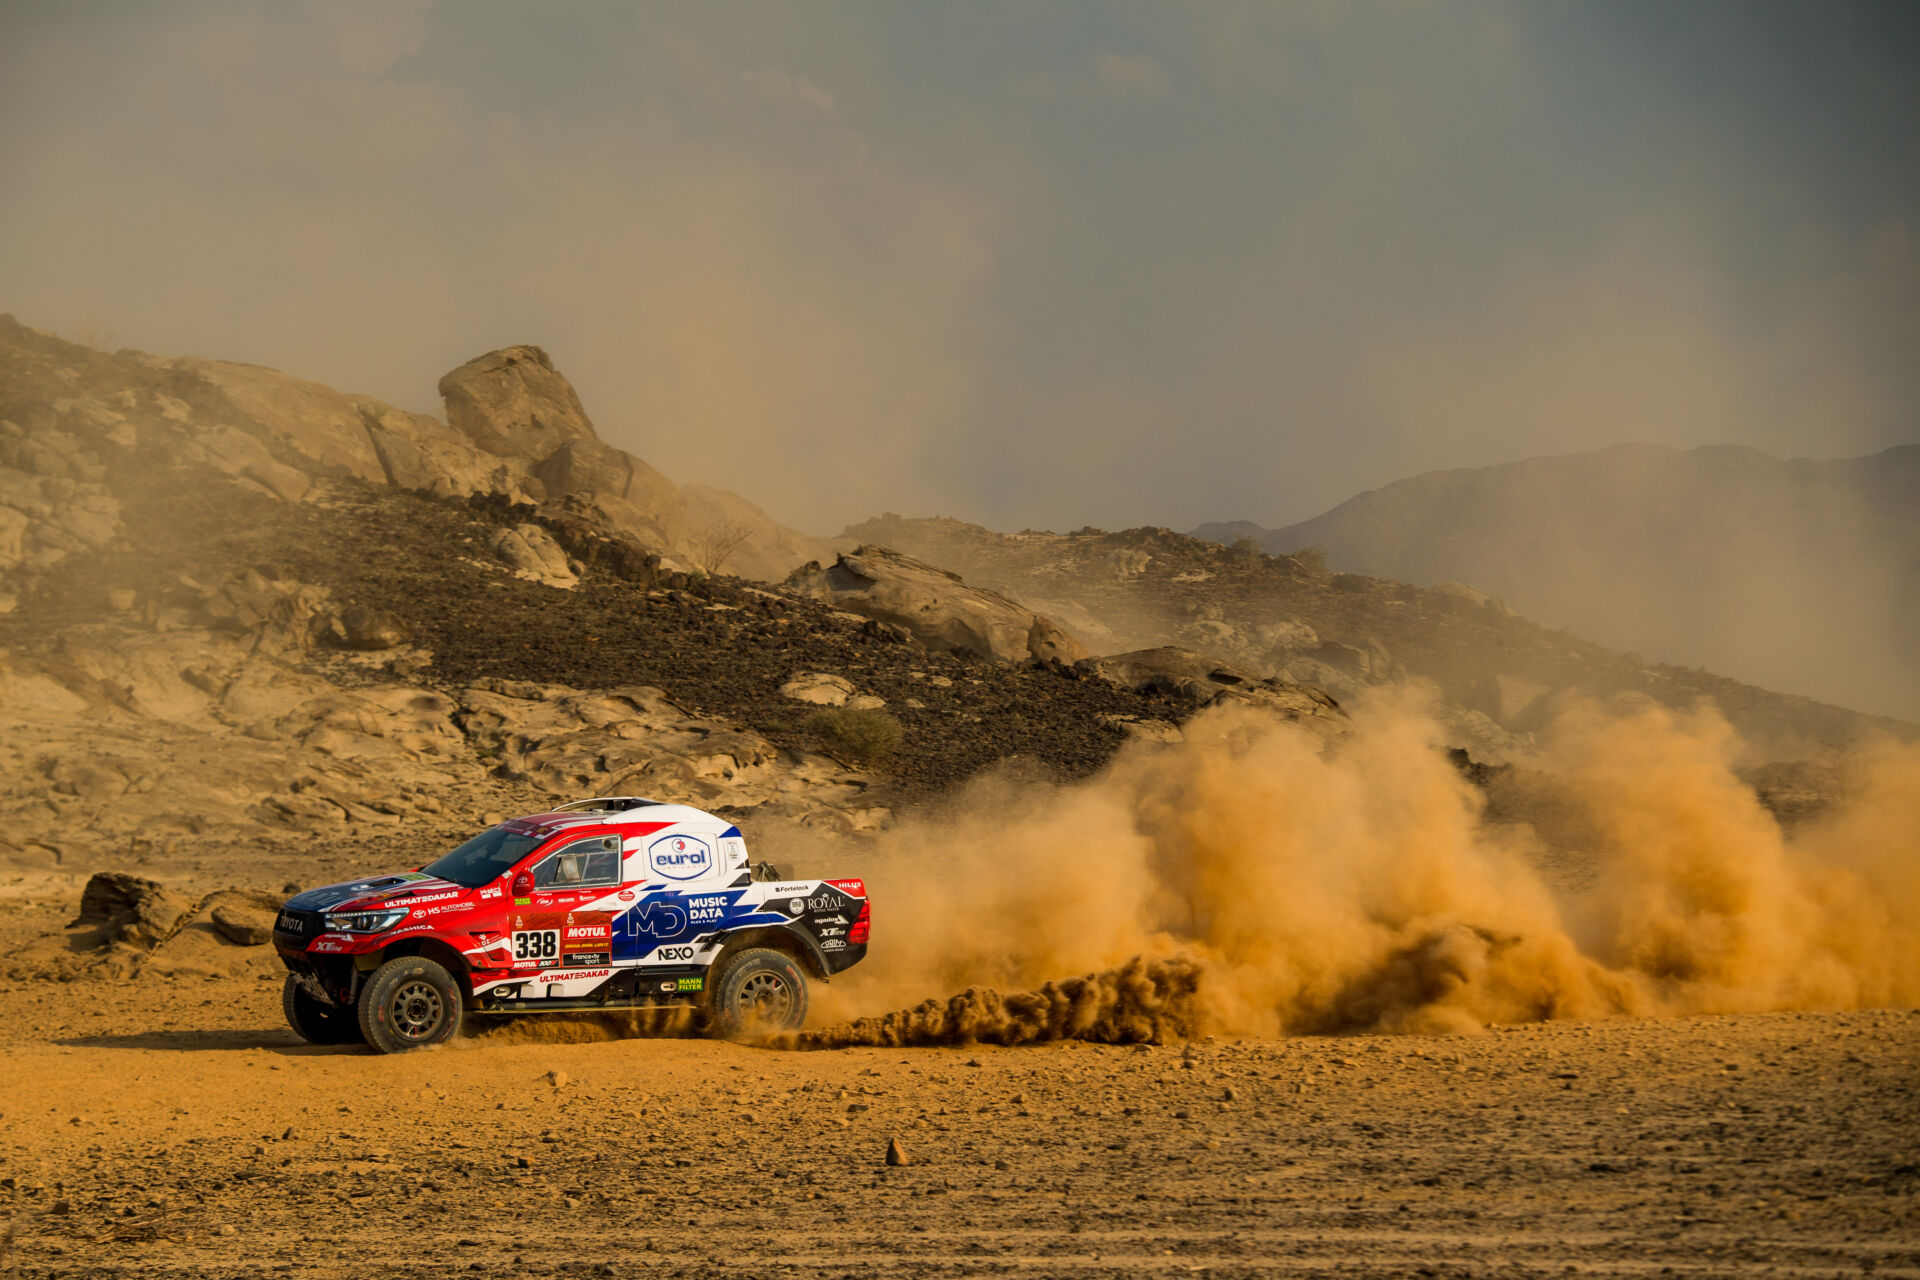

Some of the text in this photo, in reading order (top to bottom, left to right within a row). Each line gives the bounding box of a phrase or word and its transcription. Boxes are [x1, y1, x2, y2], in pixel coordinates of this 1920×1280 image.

[656, 850, 706, 866] eurol
[688, 896, 728, 908] MUSIC
[807, 896, 845, 909] ROYAL
[427, 906, 441, 915] HS
[690, 907, 724, 919] DATA
[280, 914, 304, 933] TOYOTA
[567, 926, 607, 938] MOTUL
[515, 931, 556, 958] 338
[658, 947, 694, 960] NEXO
